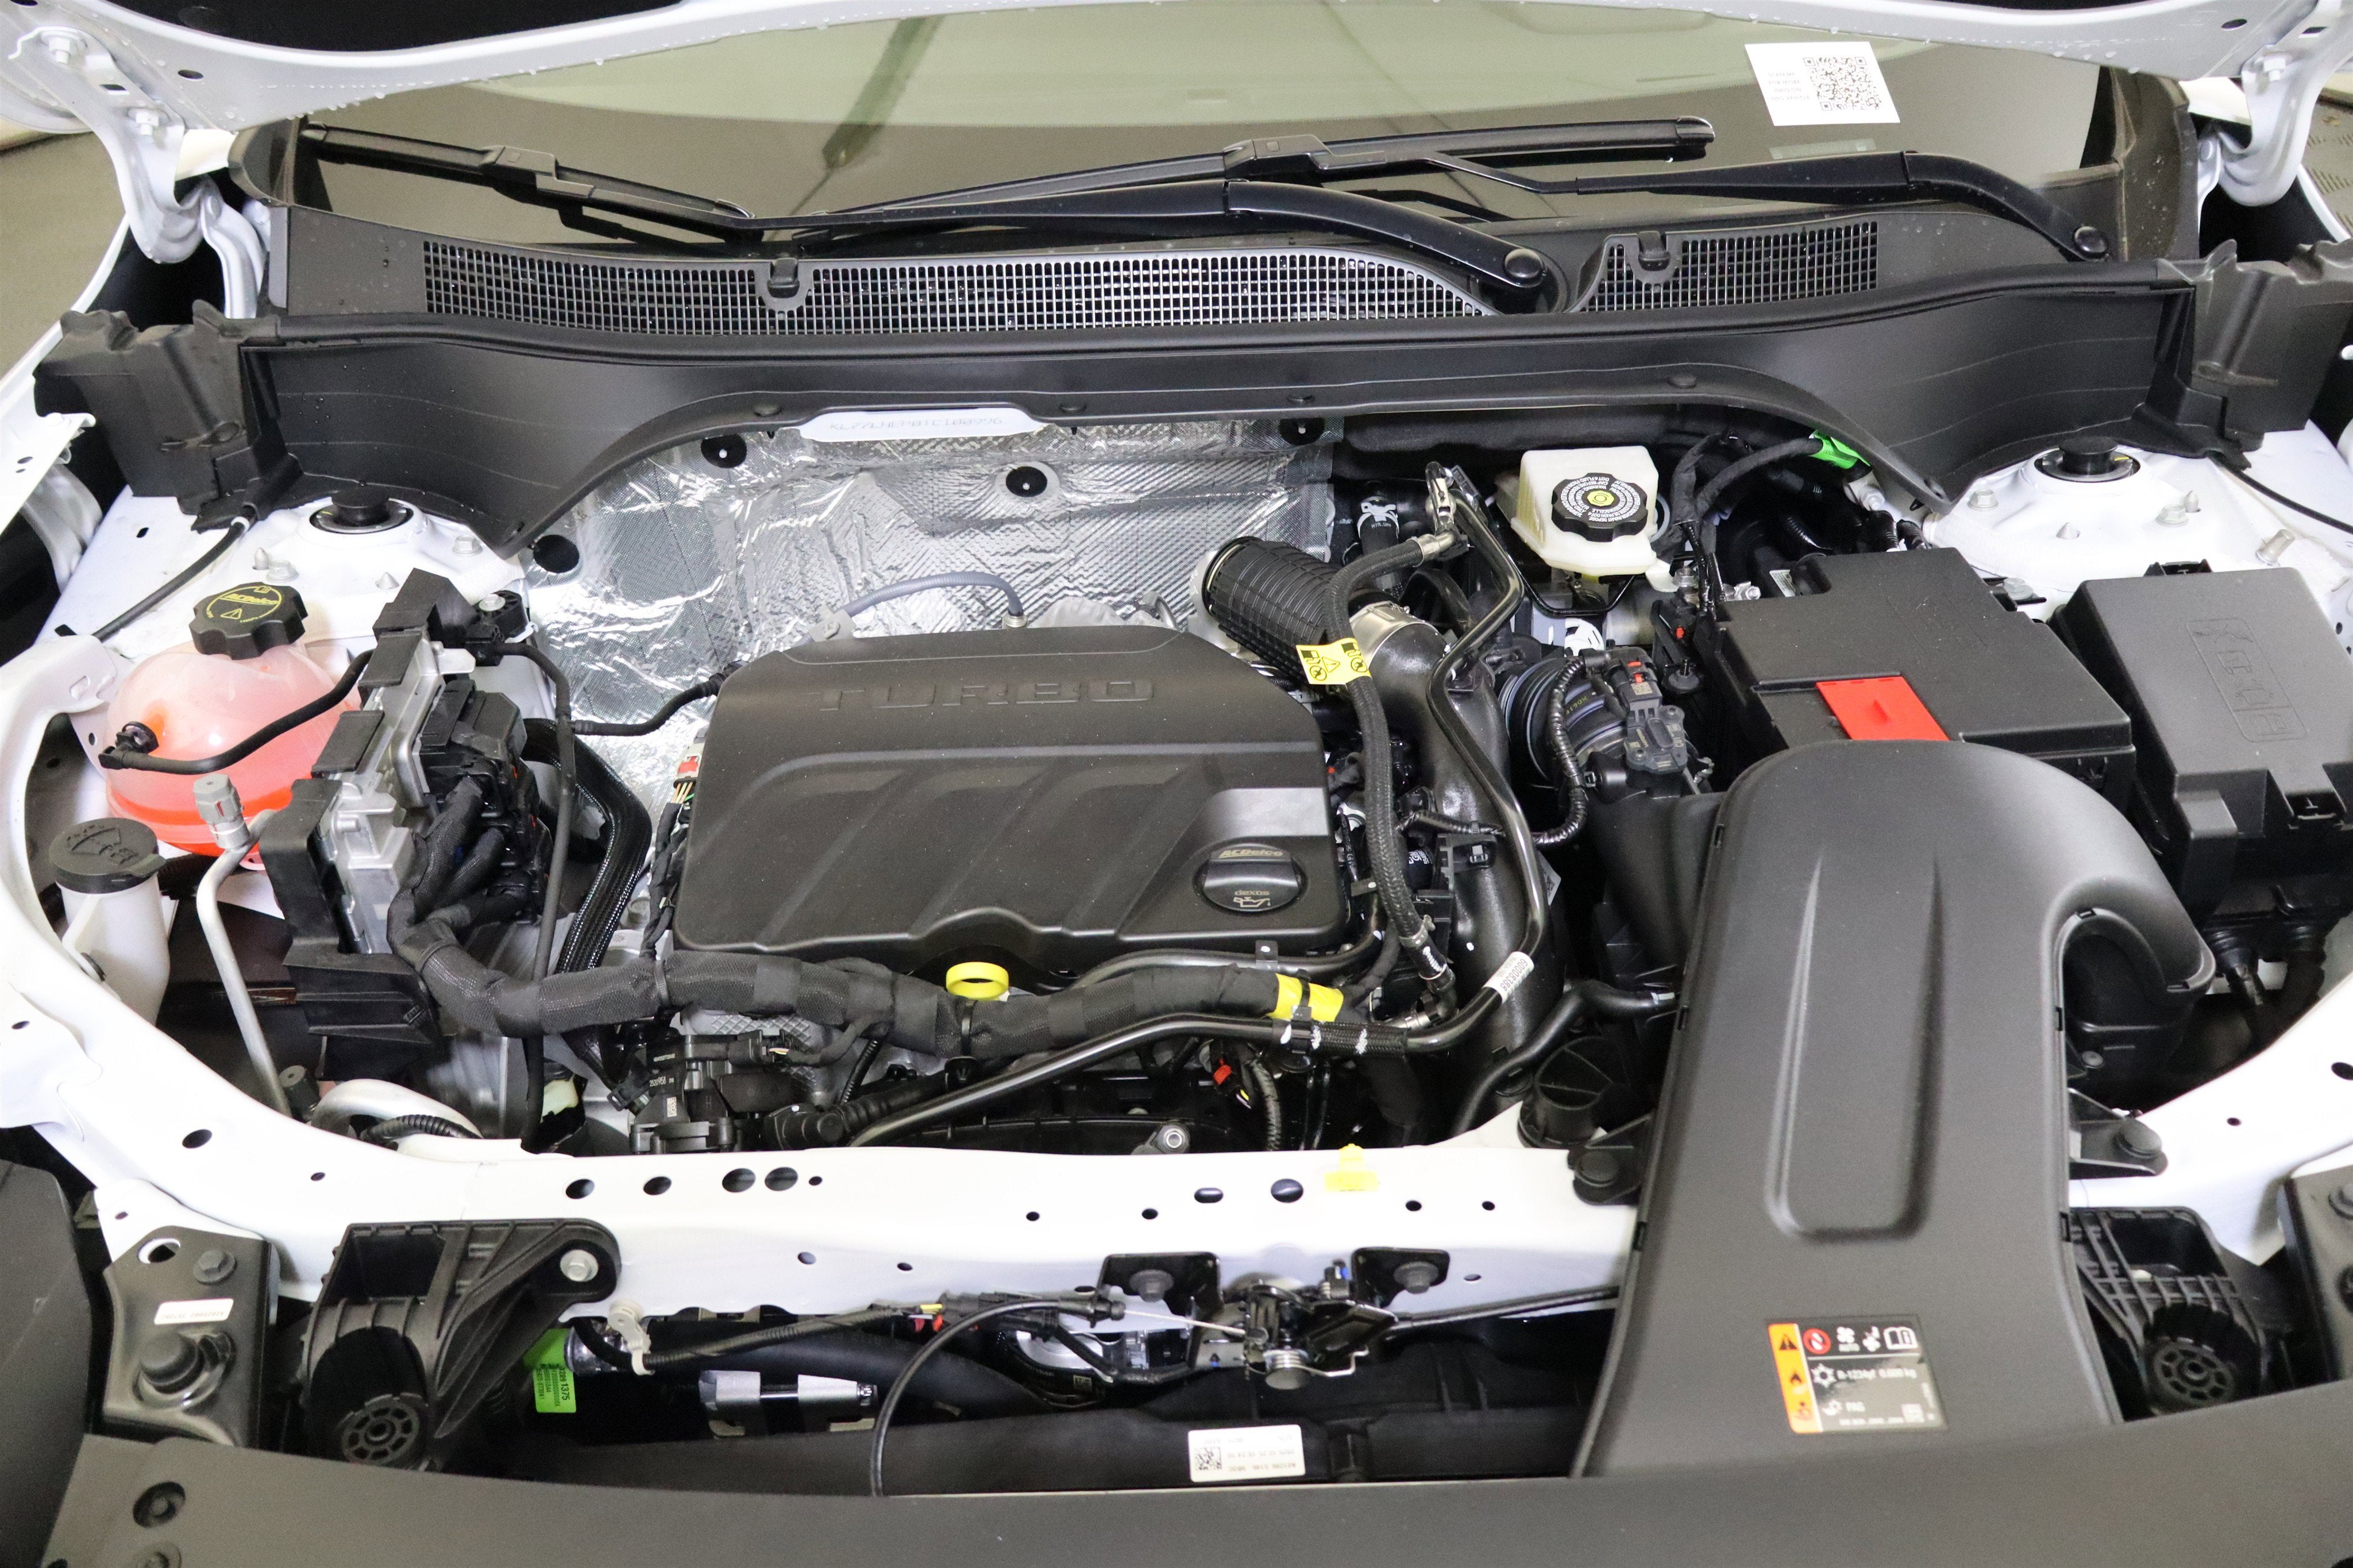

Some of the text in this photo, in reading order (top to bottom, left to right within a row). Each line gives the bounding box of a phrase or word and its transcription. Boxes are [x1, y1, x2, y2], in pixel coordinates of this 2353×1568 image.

[802, 681, 1155, 712] TURBO
[1218, 849, 1283, 858] ACDelco
[561, 1383, 570, 1401] 1375
